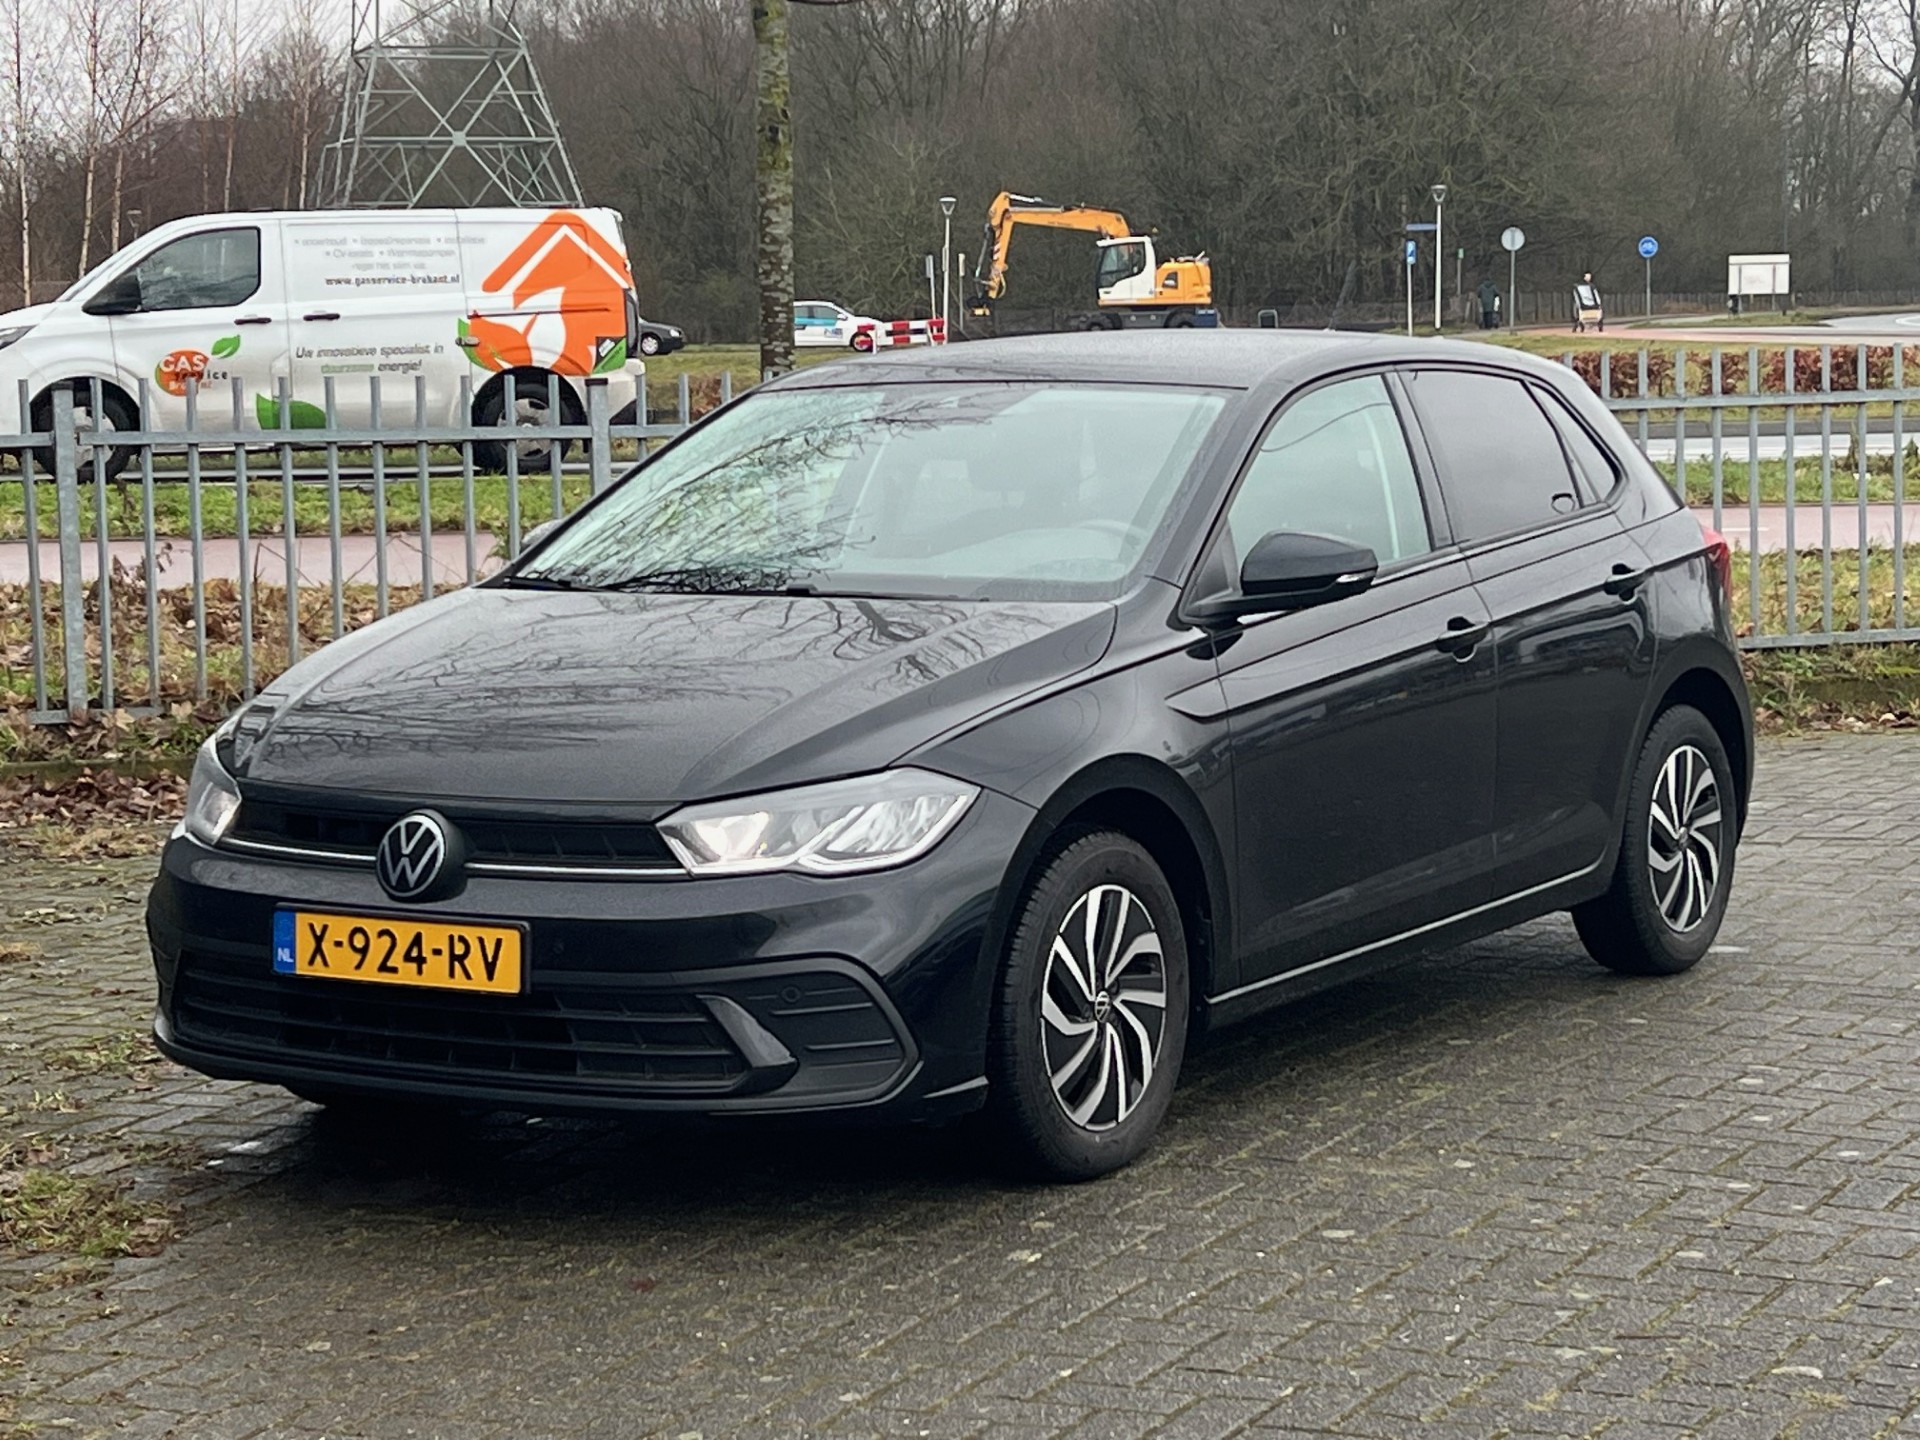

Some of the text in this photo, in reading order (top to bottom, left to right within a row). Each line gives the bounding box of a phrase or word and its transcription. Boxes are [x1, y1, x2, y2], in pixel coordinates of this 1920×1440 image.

[296, 346, 313, 358] Uw
[380, 344, 431, 359] specialist
[434, 343, 444, 354] in
[159, 354, 206, 373] GAS
[277, 947, 294, 963] NL
[307, 922, 503, 982] X-924-RV
